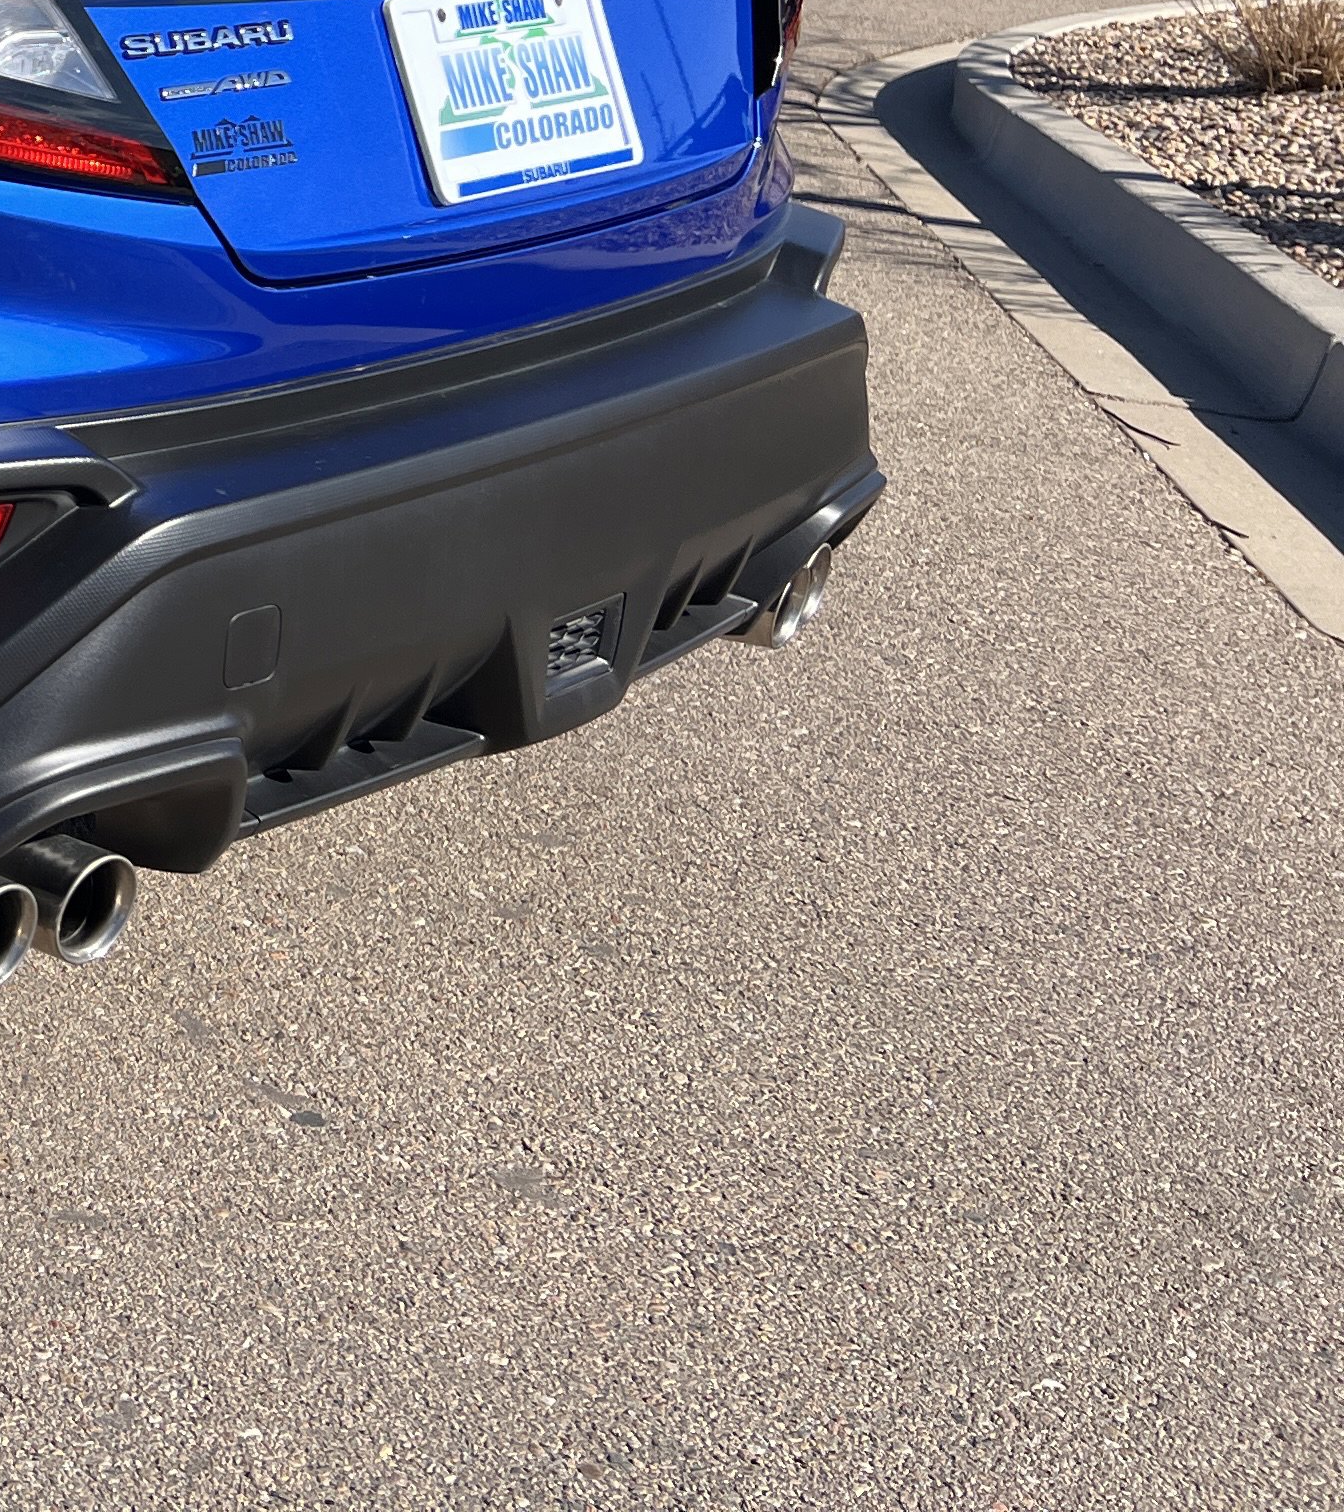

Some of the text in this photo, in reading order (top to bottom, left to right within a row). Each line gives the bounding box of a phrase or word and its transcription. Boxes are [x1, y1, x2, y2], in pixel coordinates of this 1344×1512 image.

[456, 0, 499, 30] MIKE
[120, 20, 294, 60] SUBARU
[440, 34, 592, 111] MIKE SHAW
[192, 119, 285, 153] MIKE SHAW
[495, 103, 614, 150] COLORADO
[523, 161, 570, 184] SUBARU
